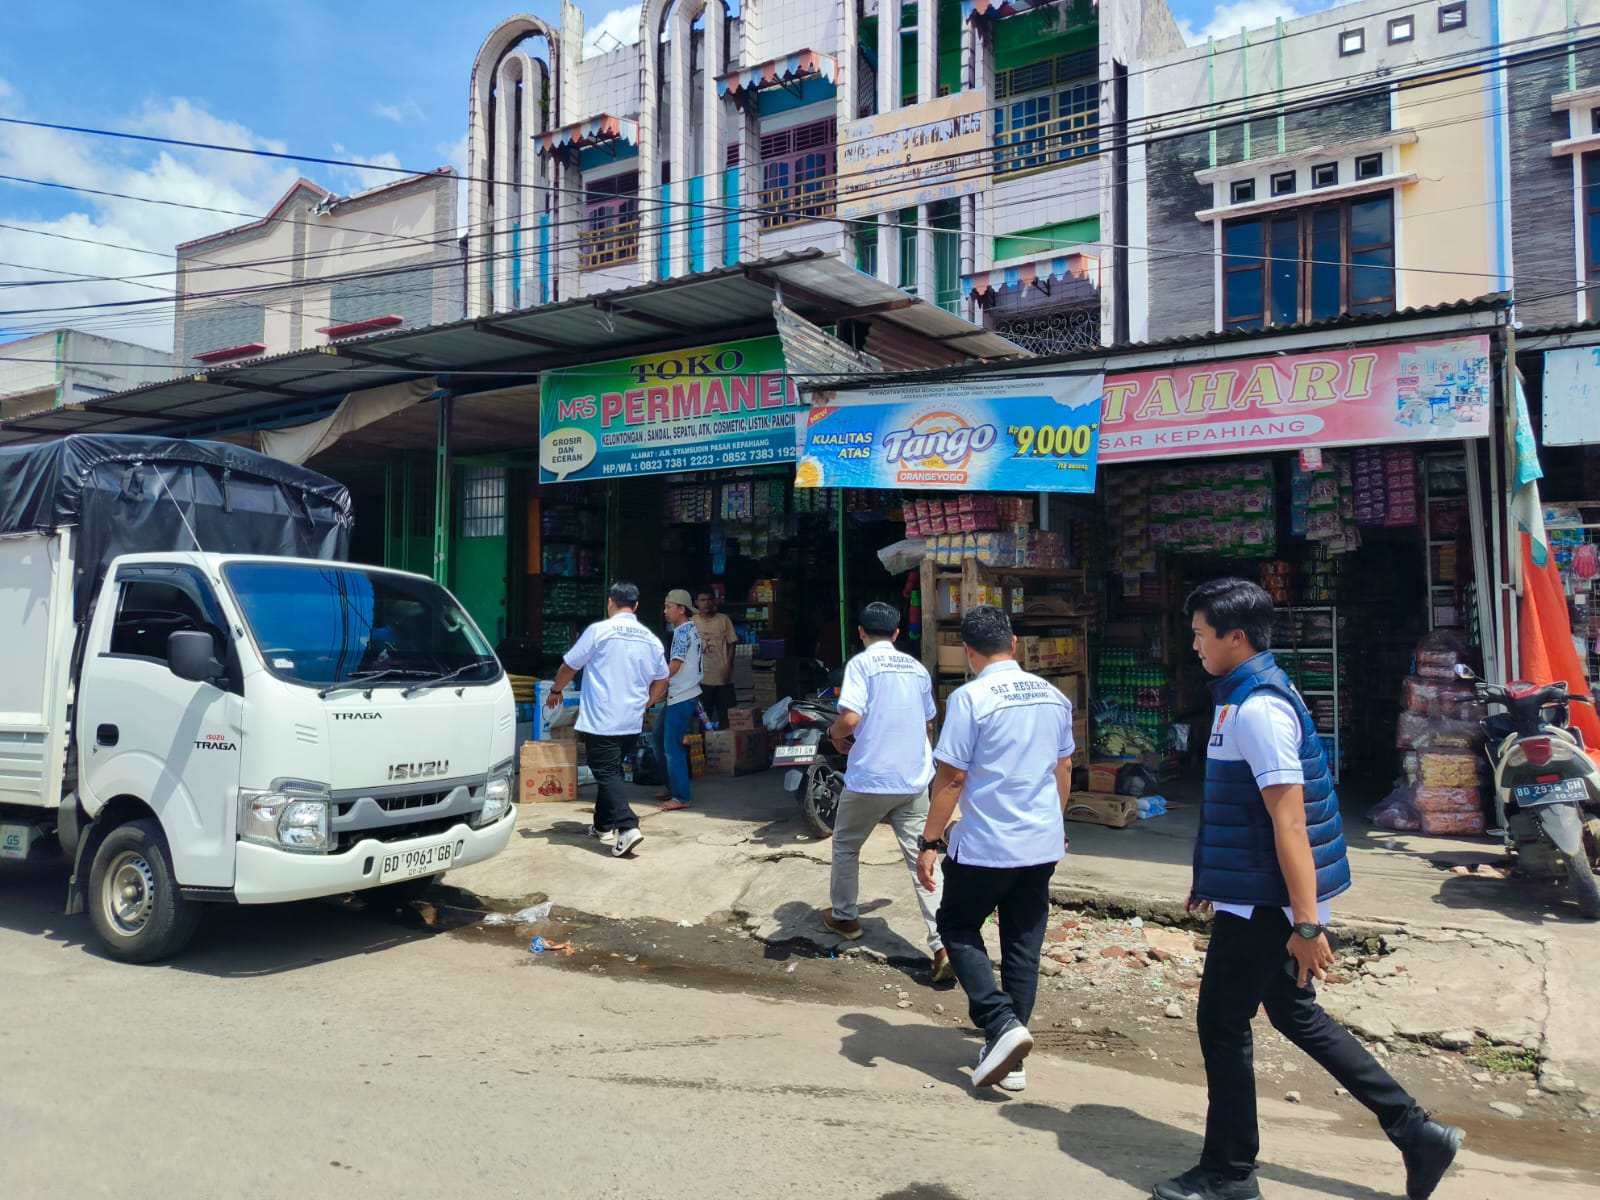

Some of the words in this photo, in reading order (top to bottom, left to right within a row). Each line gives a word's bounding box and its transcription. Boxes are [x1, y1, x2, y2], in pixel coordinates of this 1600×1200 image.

[630, 350, 744, 384] TOKO
[558, 395, 597, 421] MRS
[812, 432, 873, 445] KUALITAS
[1155, 420, 1305, 445] KEPAHIANG
[552, 436, 582, 446] GROSIR
[710, 442, 732, 452] PASAR
[883, 423, 998, 464] Tango
[558, 446, 574, 454] DAN
[837, 447, 871, 459] ATAS
[602, 462, 633, 475] HP/WA
[640, 460, 663, 471] 0823
[665, 457, 687, 469] 7381
[690, 455, 714, 466] 2223
[722, 451, 747, 463] 0852
[750, 448, 774, 460] 7383
[990, 683, 1010, 695] SAT
[332, 712, 383, 720] TRAGA
[193, 740, 237, 751] TRAGA
[388, 759, 450, 780] ISUZU
[384, 855, 399, 873] BD
[405, 848, 433, 869] 9961
[437, 844, 451, 862] GB
